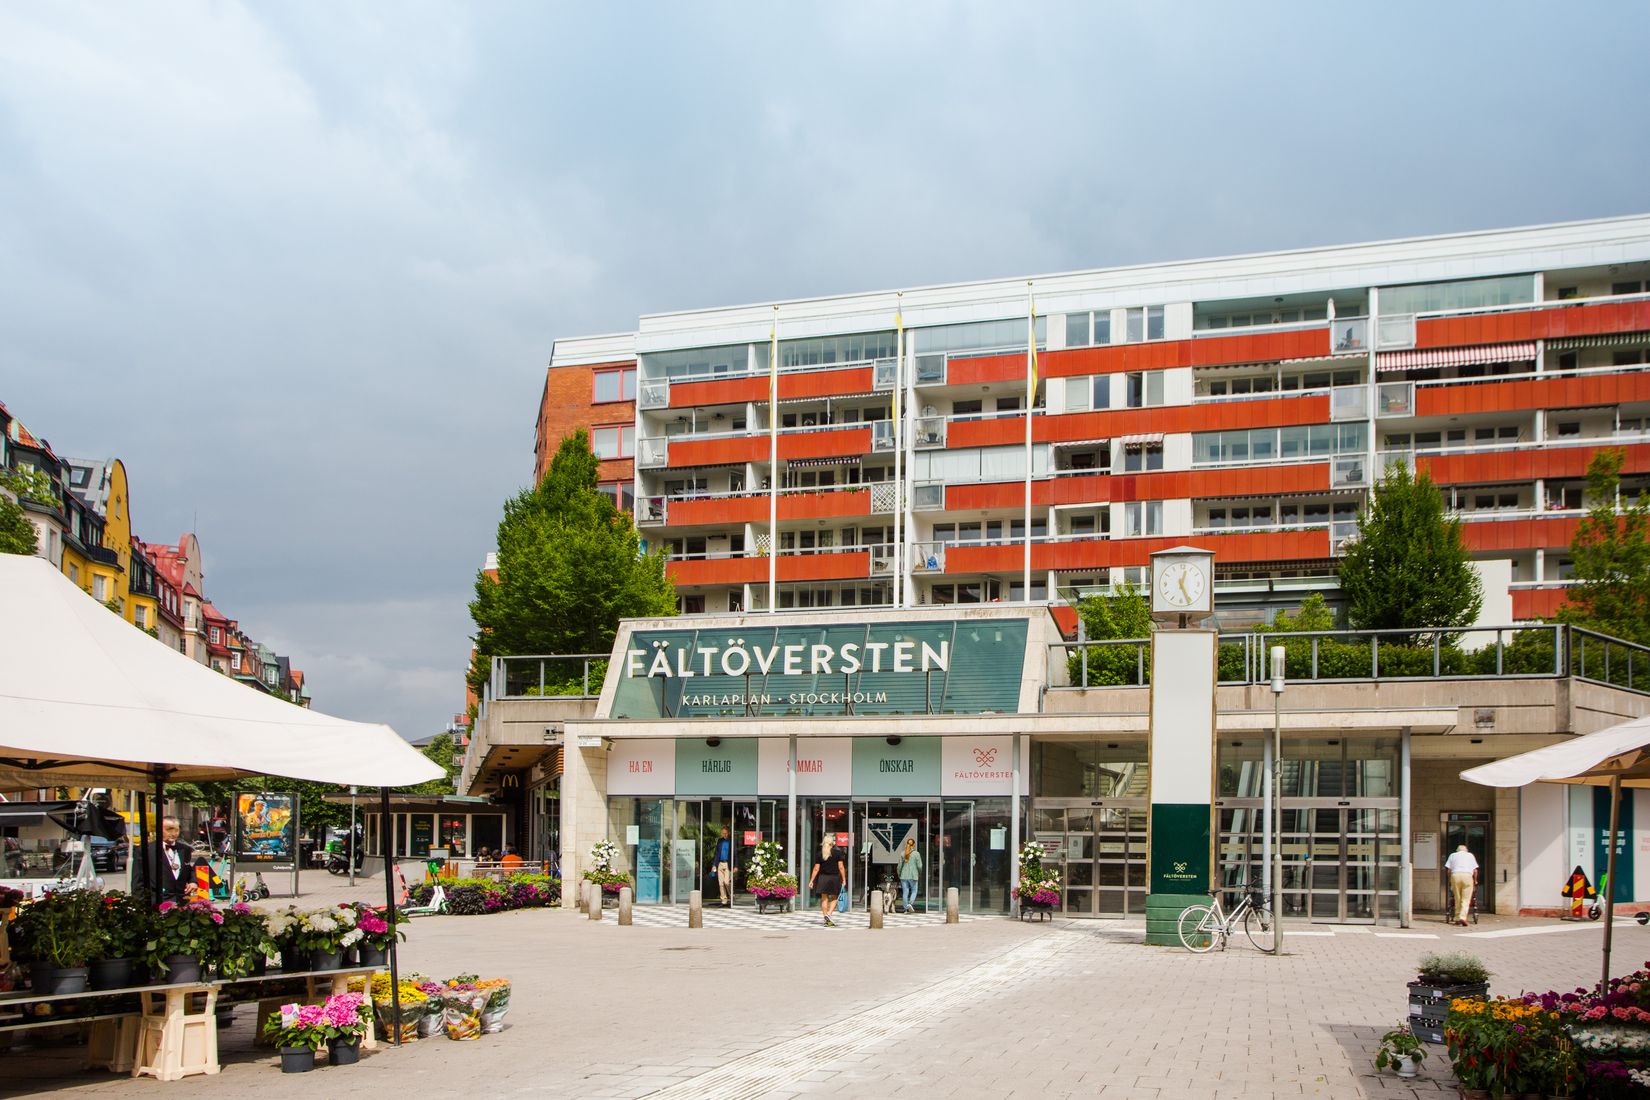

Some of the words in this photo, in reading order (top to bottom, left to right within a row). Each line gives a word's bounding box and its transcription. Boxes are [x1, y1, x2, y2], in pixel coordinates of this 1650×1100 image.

[627, 638, 949, 678] FÄLTÖVERSTEN
[682, 694, 771, 706] KARLAPLAN
[789, 692, 887, 705] STOCKHOLM
[629, 760, 640, 773] HA
[642, 760, 653, 773] EN
[702, 758, 732, 773] HÄRLIG
[787, 760, 823, 773] SMMAR
[879, 757, 914, 773] ÖNSKAR
